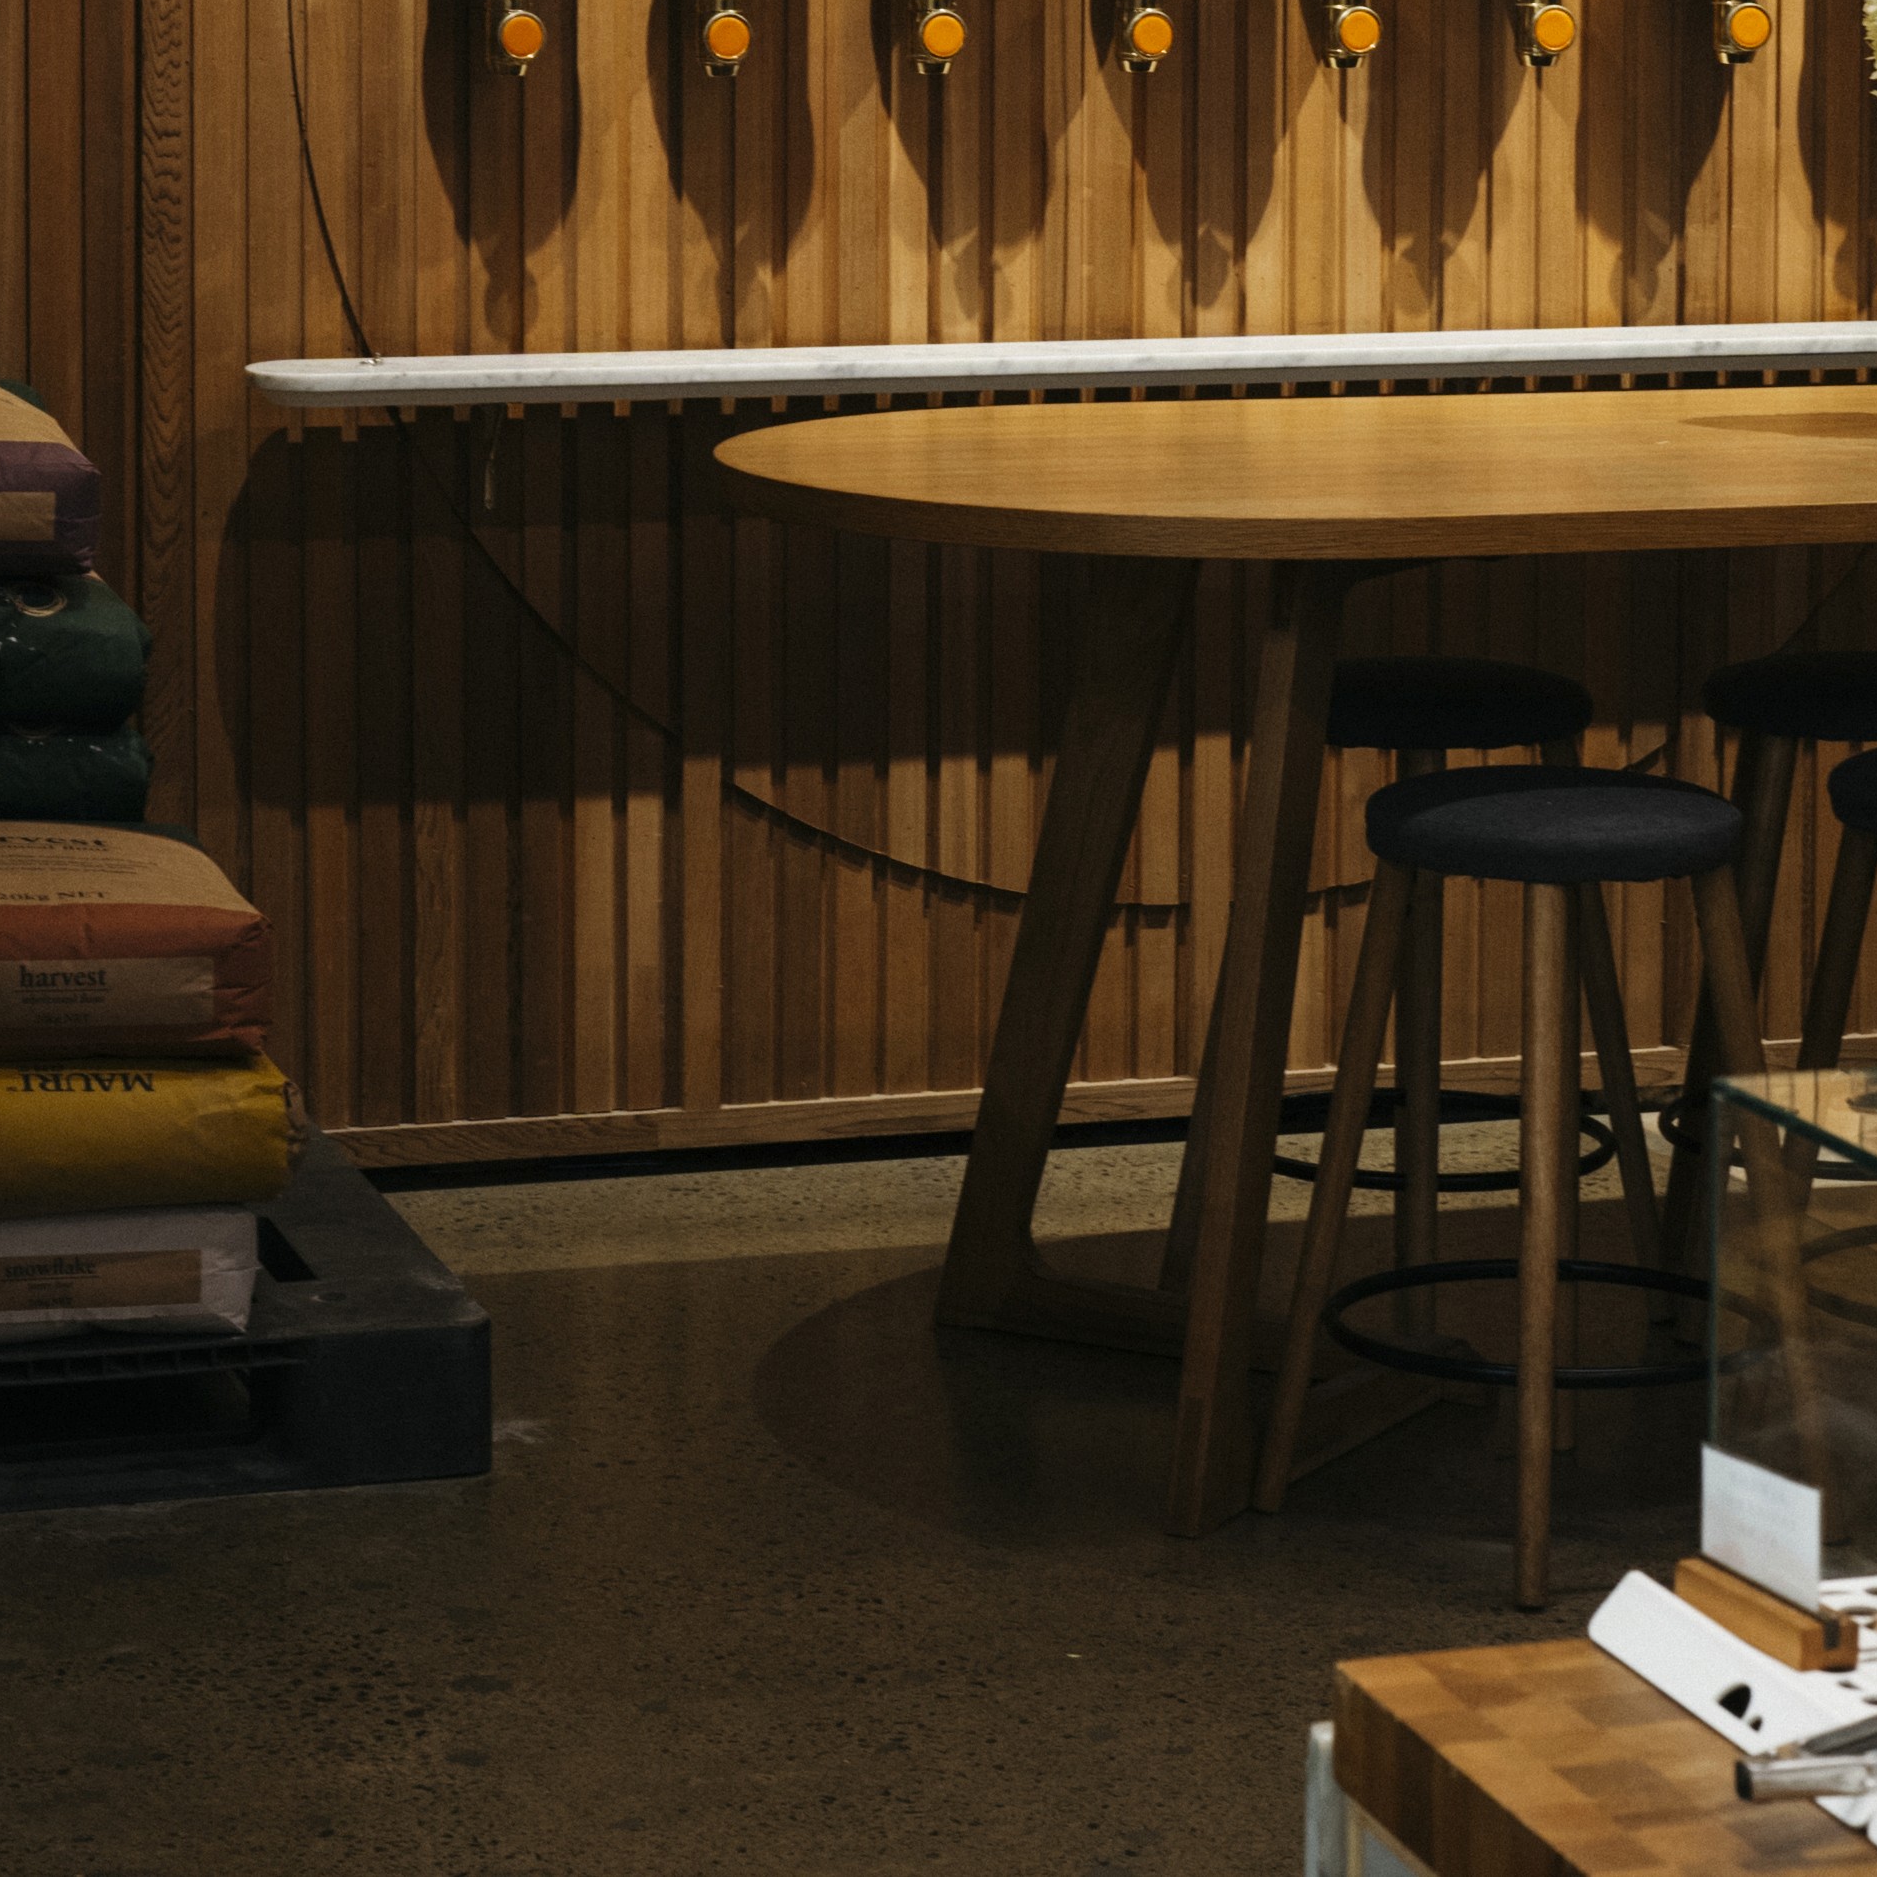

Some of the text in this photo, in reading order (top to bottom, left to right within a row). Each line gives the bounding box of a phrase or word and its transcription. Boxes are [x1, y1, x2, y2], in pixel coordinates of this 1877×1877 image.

[56, 890, 108, 900] NET
[19, 965, 106, 987] harvest
[23, 1072, 156, 1091] MAURI
[5, 1255, 96, 1278] snowflake
